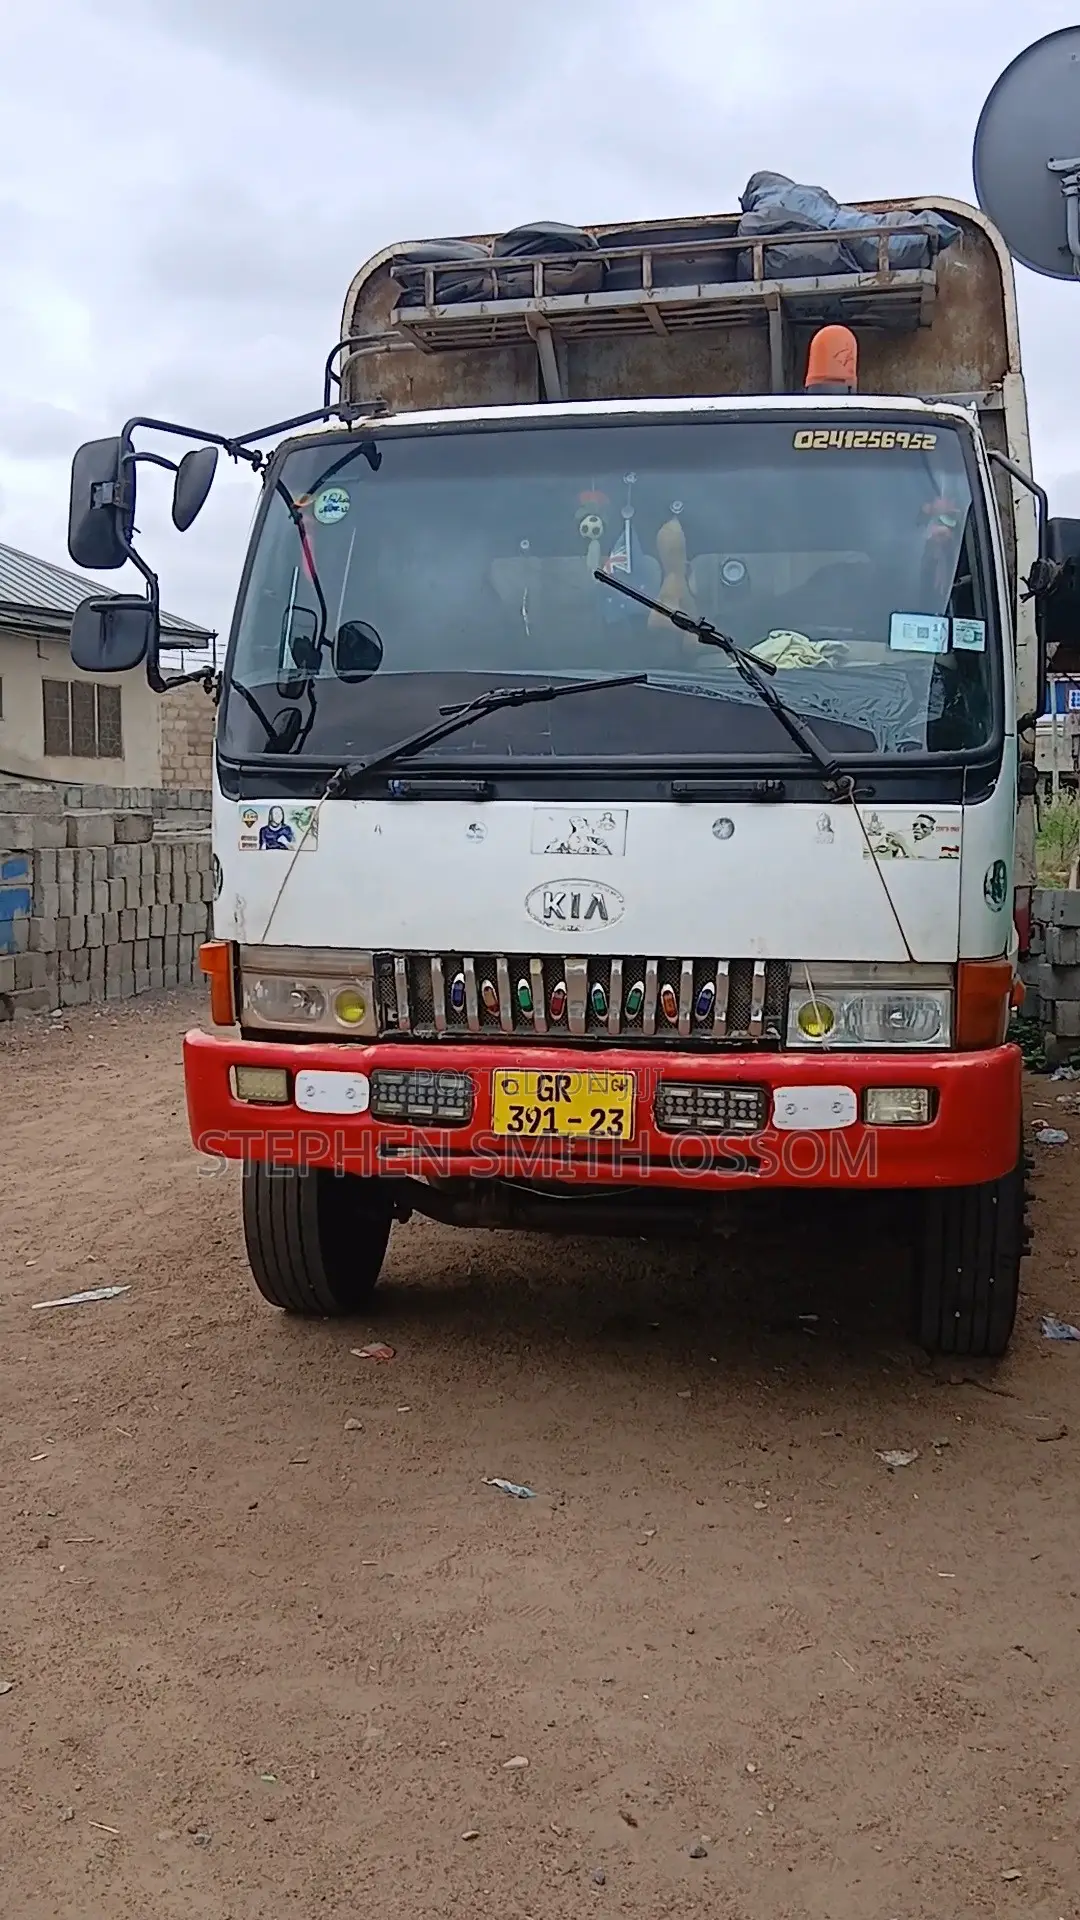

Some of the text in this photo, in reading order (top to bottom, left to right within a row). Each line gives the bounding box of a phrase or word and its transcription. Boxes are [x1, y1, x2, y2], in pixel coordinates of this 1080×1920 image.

[793, 429, 938, 451] 0241256952
[543, 891, 609, 921] KIA
[537, 1074, 572, 1103] GR
[507, 1105, 559, 1134] 391
[590, 1108, 625, 1137] 23
